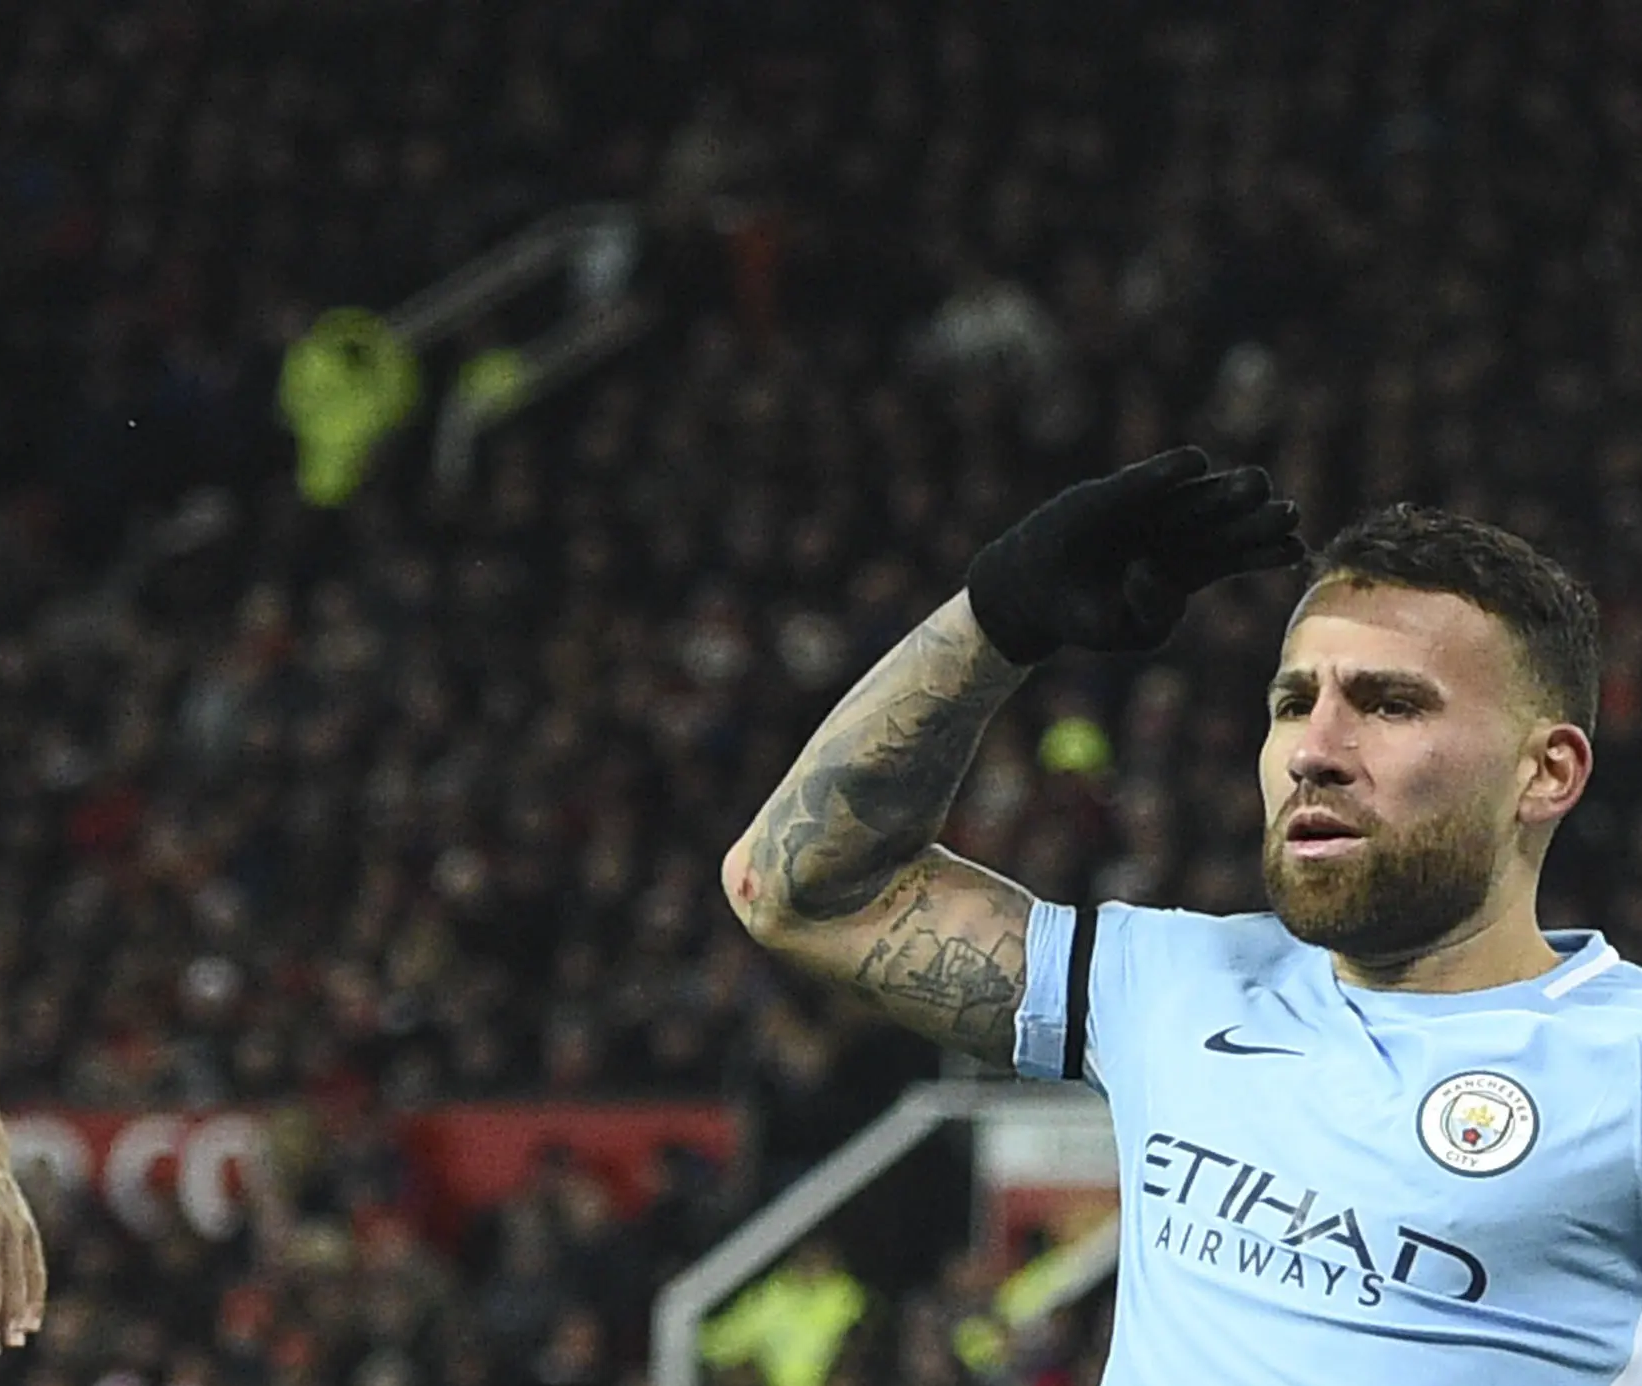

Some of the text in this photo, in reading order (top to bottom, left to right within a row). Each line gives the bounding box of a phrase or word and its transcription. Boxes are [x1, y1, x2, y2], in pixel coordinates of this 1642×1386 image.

[1441, 1078, 1529, 1122] MANCHESTER
[1445, 1150, 1479, 1167] CITY
[1143, 1132, 1488, 1304] ETIHAD
[1155, 1216, 1386, 1308] AIRWAYS
